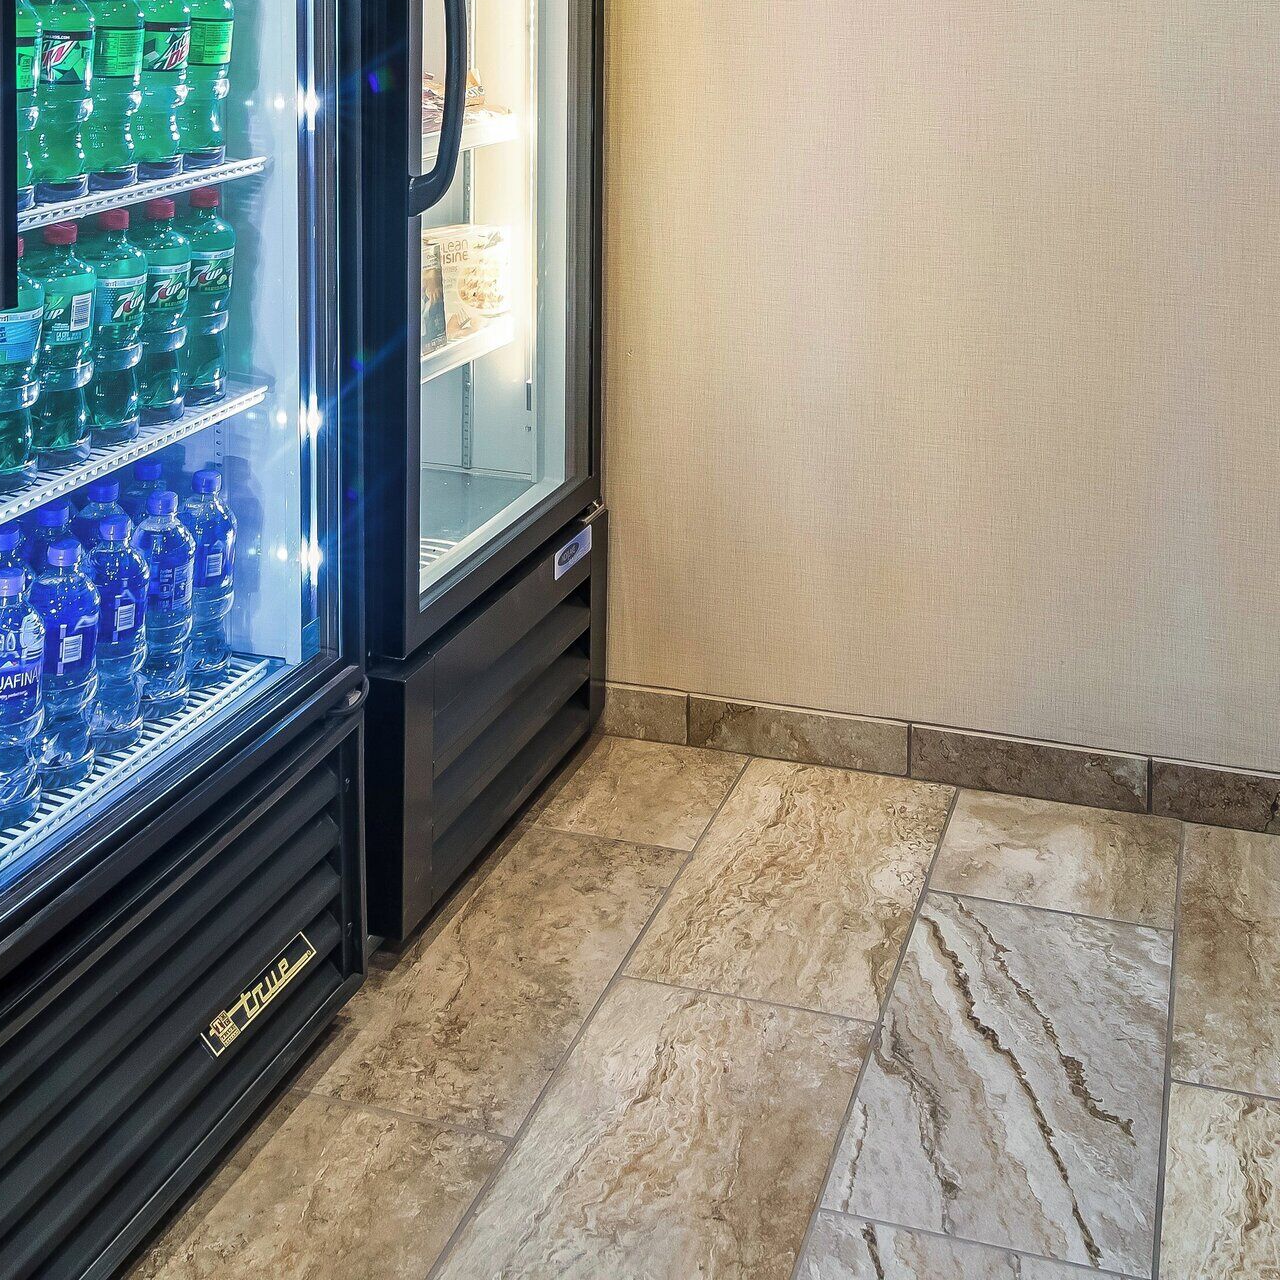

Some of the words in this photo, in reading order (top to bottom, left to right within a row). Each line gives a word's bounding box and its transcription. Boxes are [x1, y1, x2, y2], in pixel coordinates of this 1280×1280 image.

[442, 250, 469, 265] ISINE
[148, 278, 183, 304] 7UP
[235, 957, 290, 1019] true
